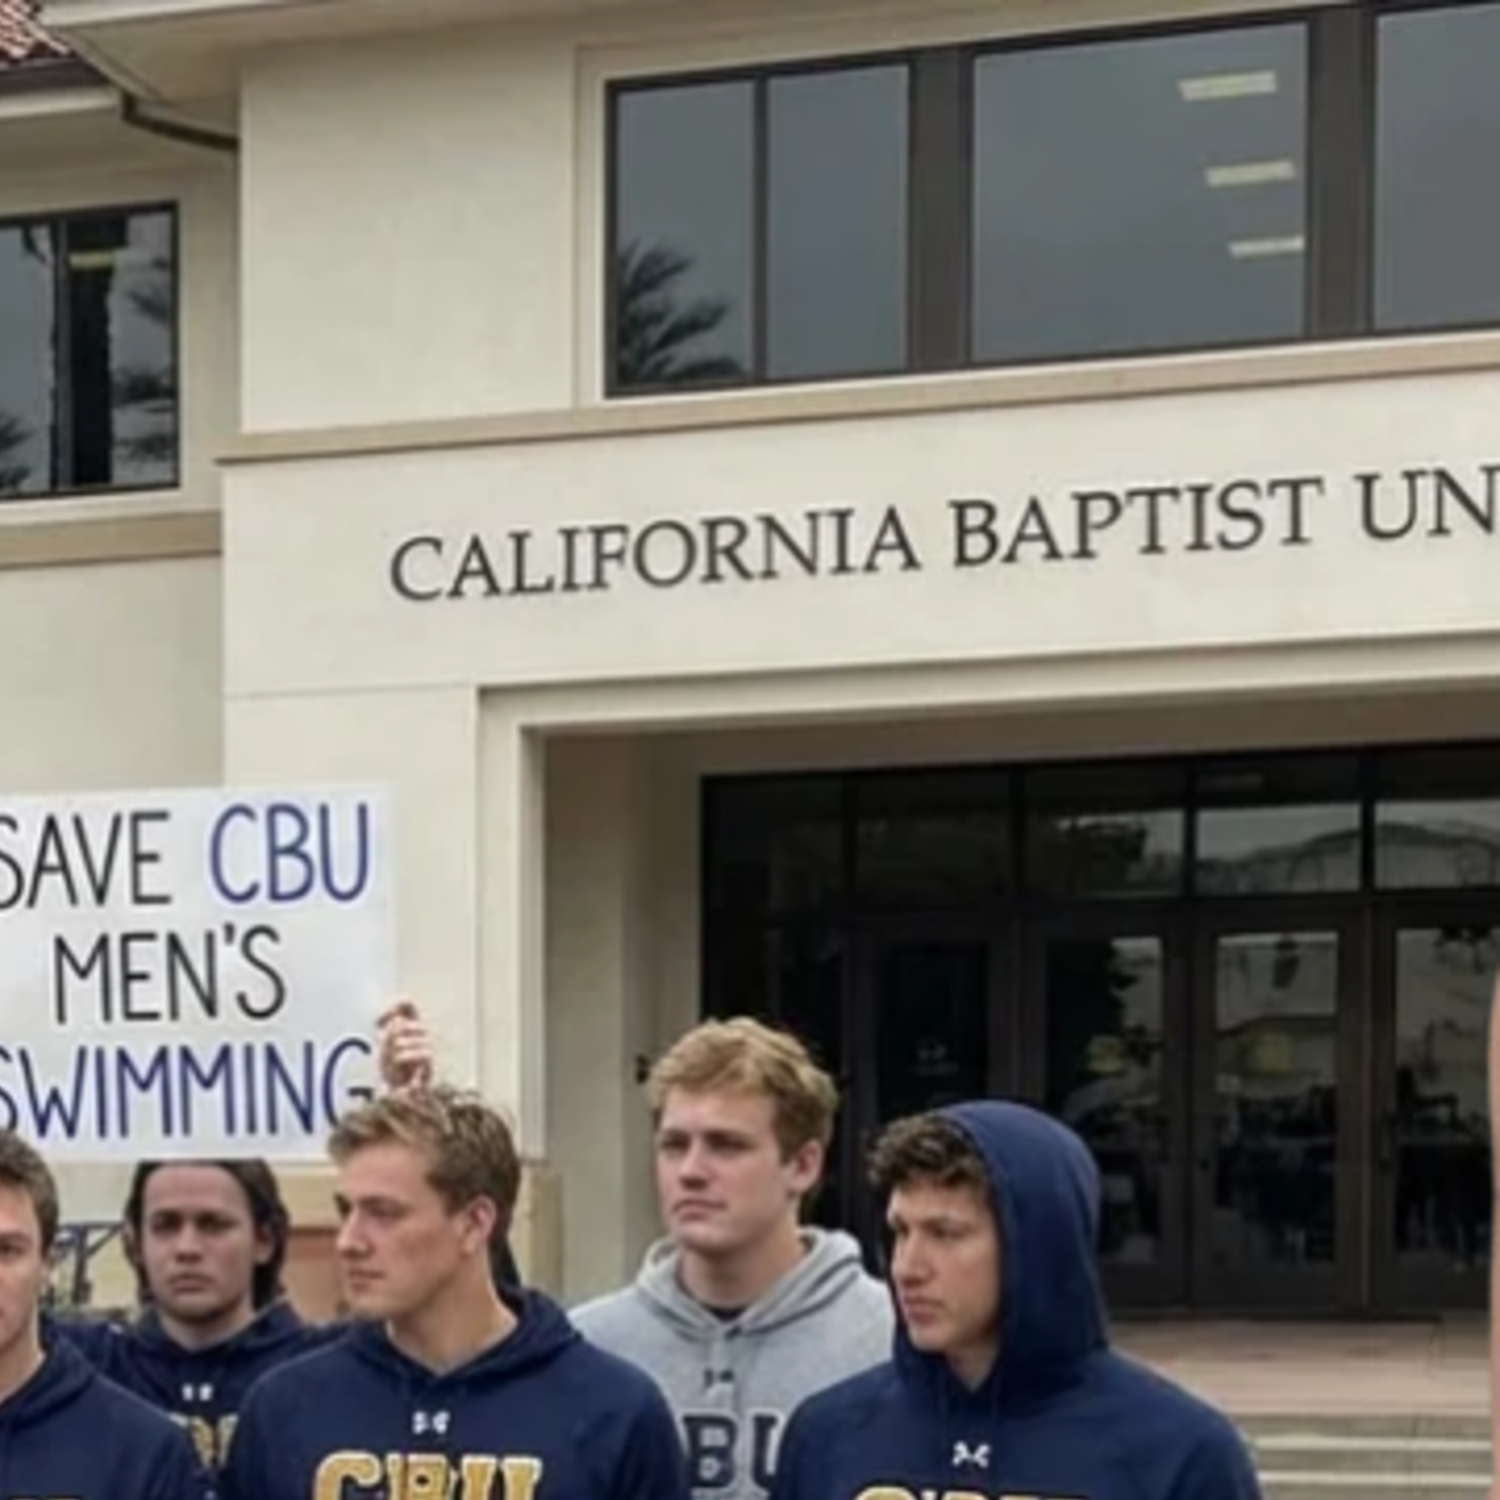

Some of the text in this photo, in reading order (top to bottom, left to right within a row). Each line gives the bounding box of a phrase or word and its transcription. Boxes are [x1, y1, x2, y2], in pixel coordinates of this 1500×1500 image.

[389, 464, 1500, 602] CALIFORNIA BAPTIST UN
[209, 802, 369, 904] CBU
[54, 922, 286, 1025] MEN'S
